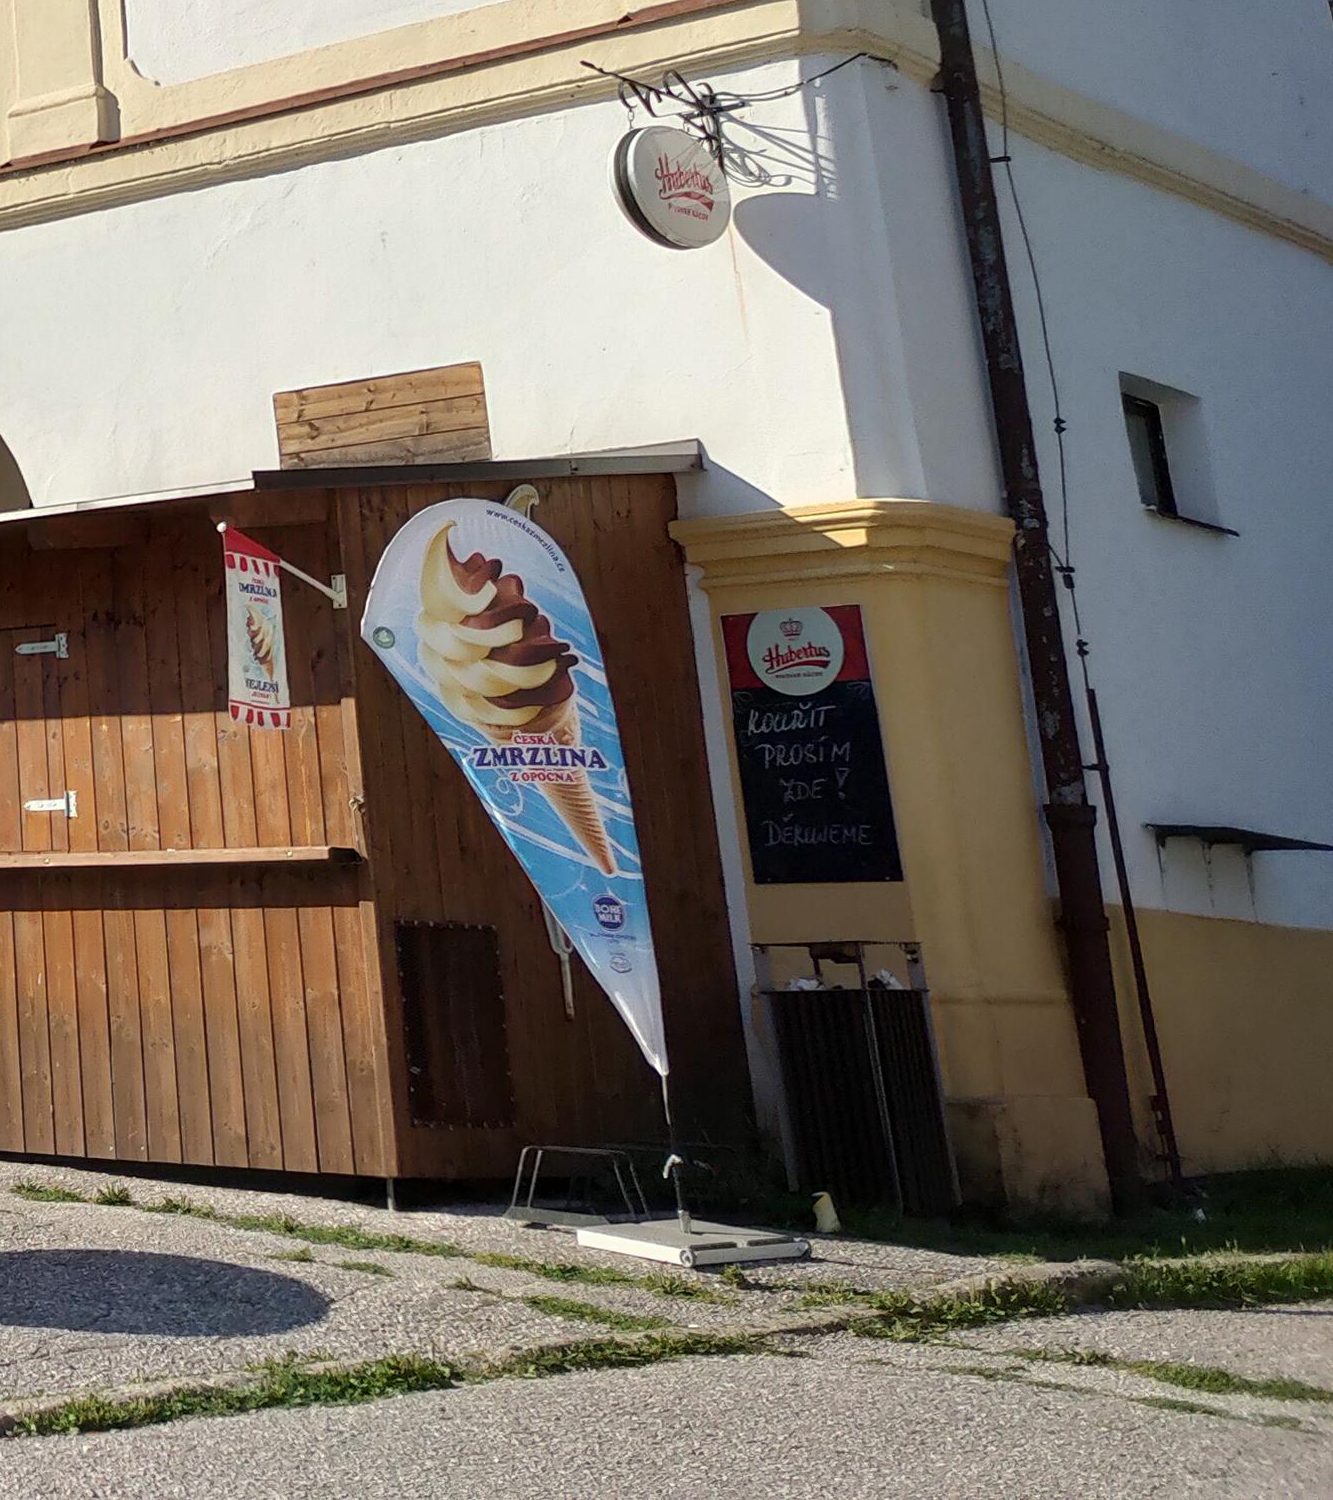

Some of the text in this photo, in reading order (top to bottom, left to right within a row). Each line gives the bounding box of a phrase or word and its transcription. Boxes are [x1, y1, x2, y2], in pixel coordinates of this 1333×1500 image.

[762, 641, 831, 670] Hubertus
[747, 702, 836, 736] KOUŘIT
[473, 747, 607, 769] ZMRZLINA
[753, 736, 851, 769] PROSÍM
[511, 772, 519, 782] Z
